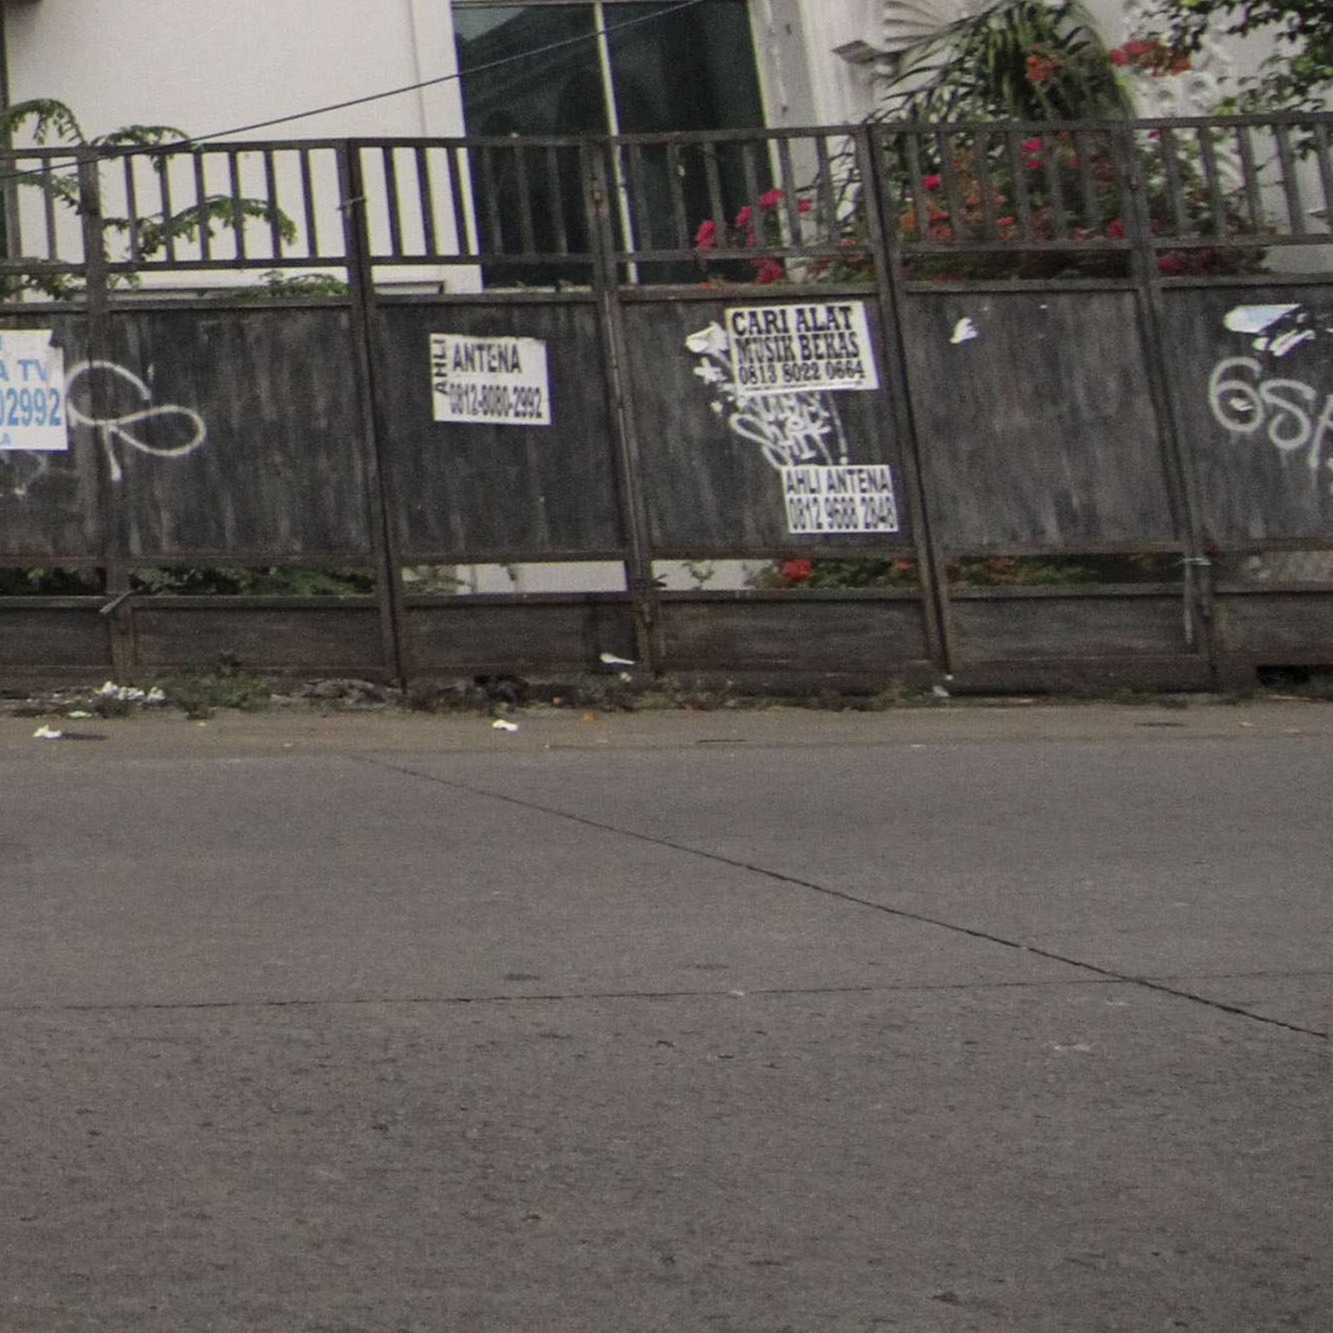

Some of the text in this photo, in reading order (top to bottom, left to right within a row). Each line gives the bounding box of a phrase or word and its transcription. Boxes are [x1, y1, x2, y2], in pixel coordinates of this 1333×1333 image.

[733, 306, 852, 335] CARI ALAT
[453, 343, 522, 373] ANTENA
[735, 332, 859, 363] MUSIK BEKAS
[434, 339, 448, 396] AHLI
[739, 364, 776, 385] 0813
[787, 468, 893, 494] AHLI ANTENA
[789, 497, 823, 531] 0812
